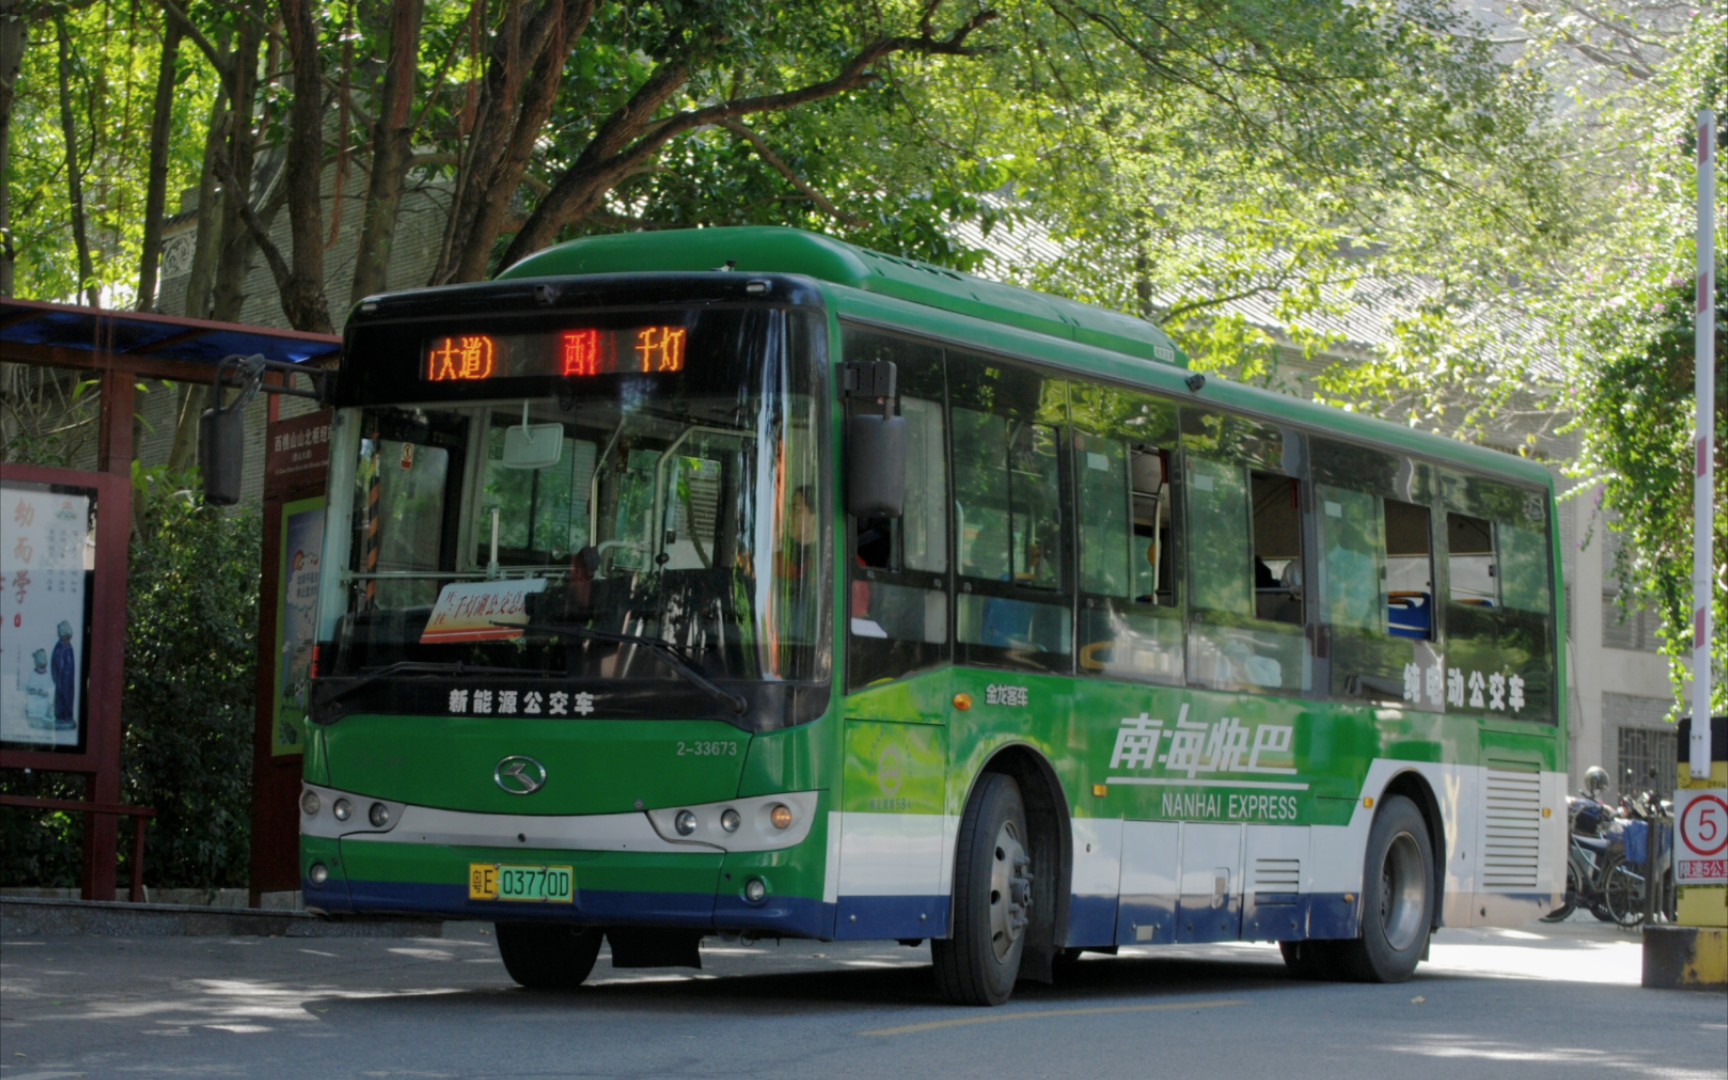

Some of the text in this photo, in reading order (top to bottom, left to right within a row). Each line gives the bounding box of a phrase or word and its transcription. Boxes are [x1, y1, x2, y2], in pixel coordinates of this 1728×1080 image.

[635, 326, 686, 373] 千灯
[12, 498, 36, 604] 幼而学
[448, 688, 595, 716] 新能源公交车
[985, 684, 1029, 707] 金龙客车
[1403, 662, 1525, 713] 纯电动公交车
[676, 740, 738, 756] 2-33673
[1109, 703, 1298, 779] 南海快巴
[1161, 792, 1298, 820] NANHAI EXPRESS
[1698, 809, 1718, 842] 5
